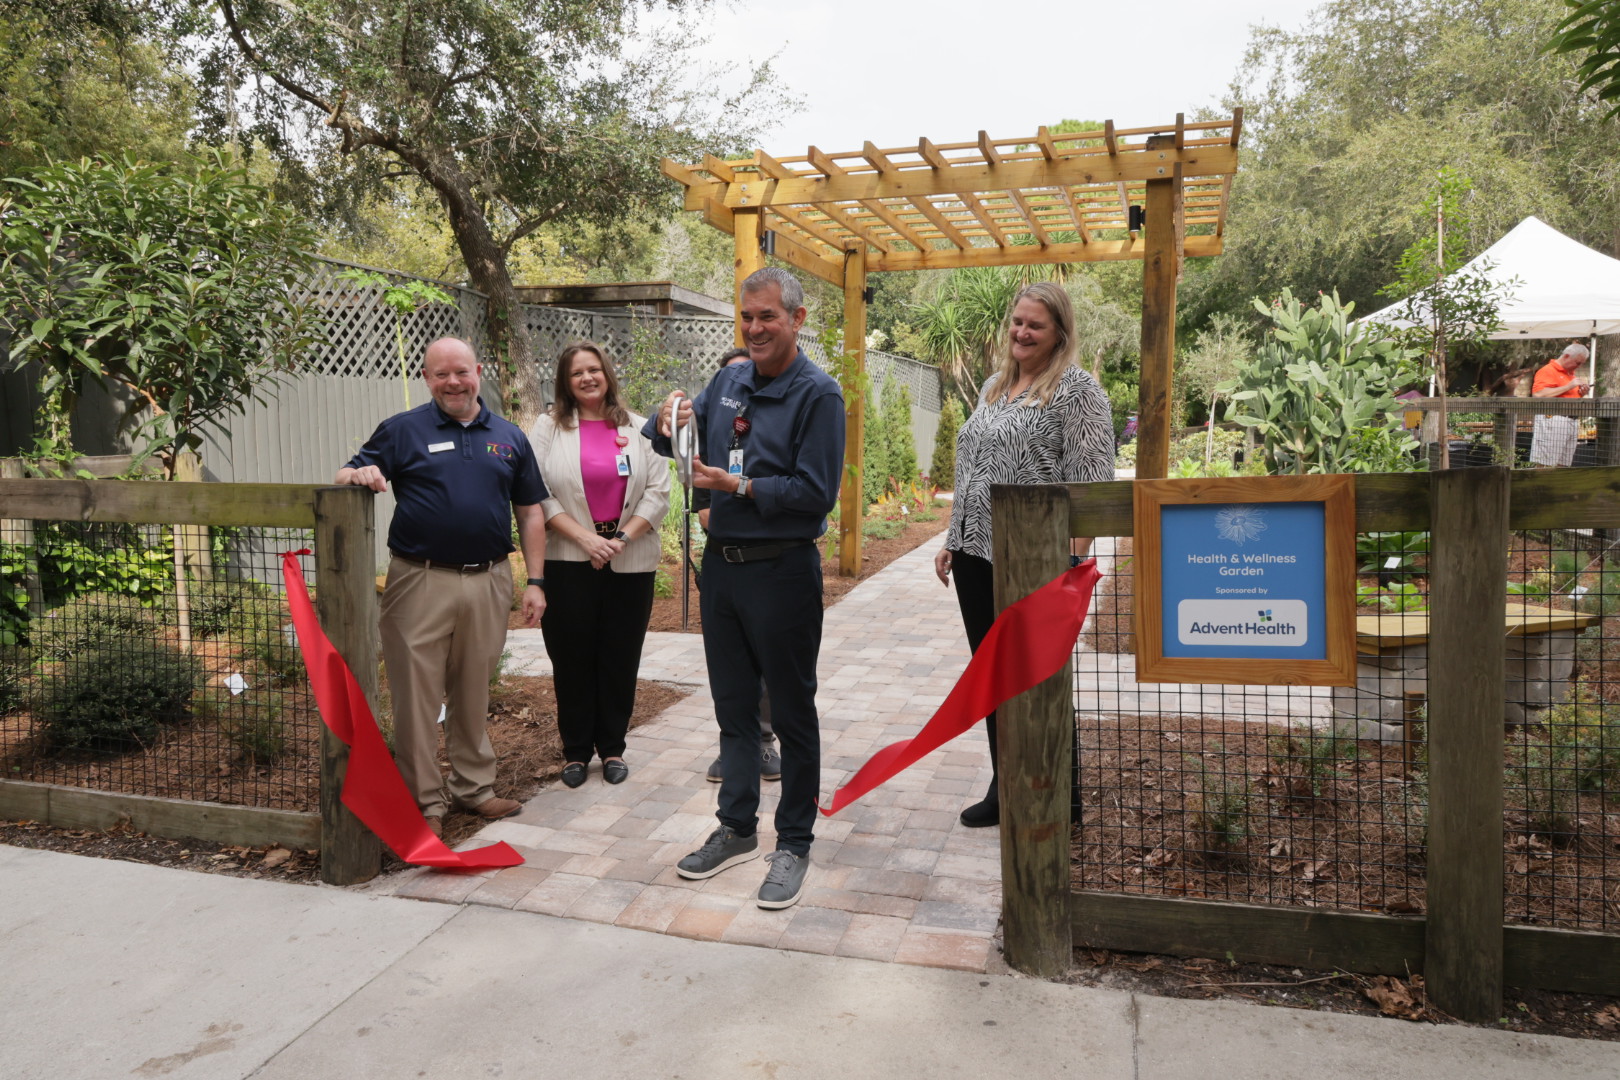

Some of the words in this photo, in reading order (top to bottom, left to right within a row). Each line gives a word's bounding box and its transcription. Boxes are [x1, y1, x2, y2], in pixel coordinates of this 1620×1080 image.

[1187, 554, 1227, 564] Health
[1230, 554, 1240, 564] &
[1242, 553, 1297, 563] Wellness
[1219, 566, 1264, 576] Garden
[1215, 587, 1257, 595] Sponsored
[1258, 587, 1268, 595] by
